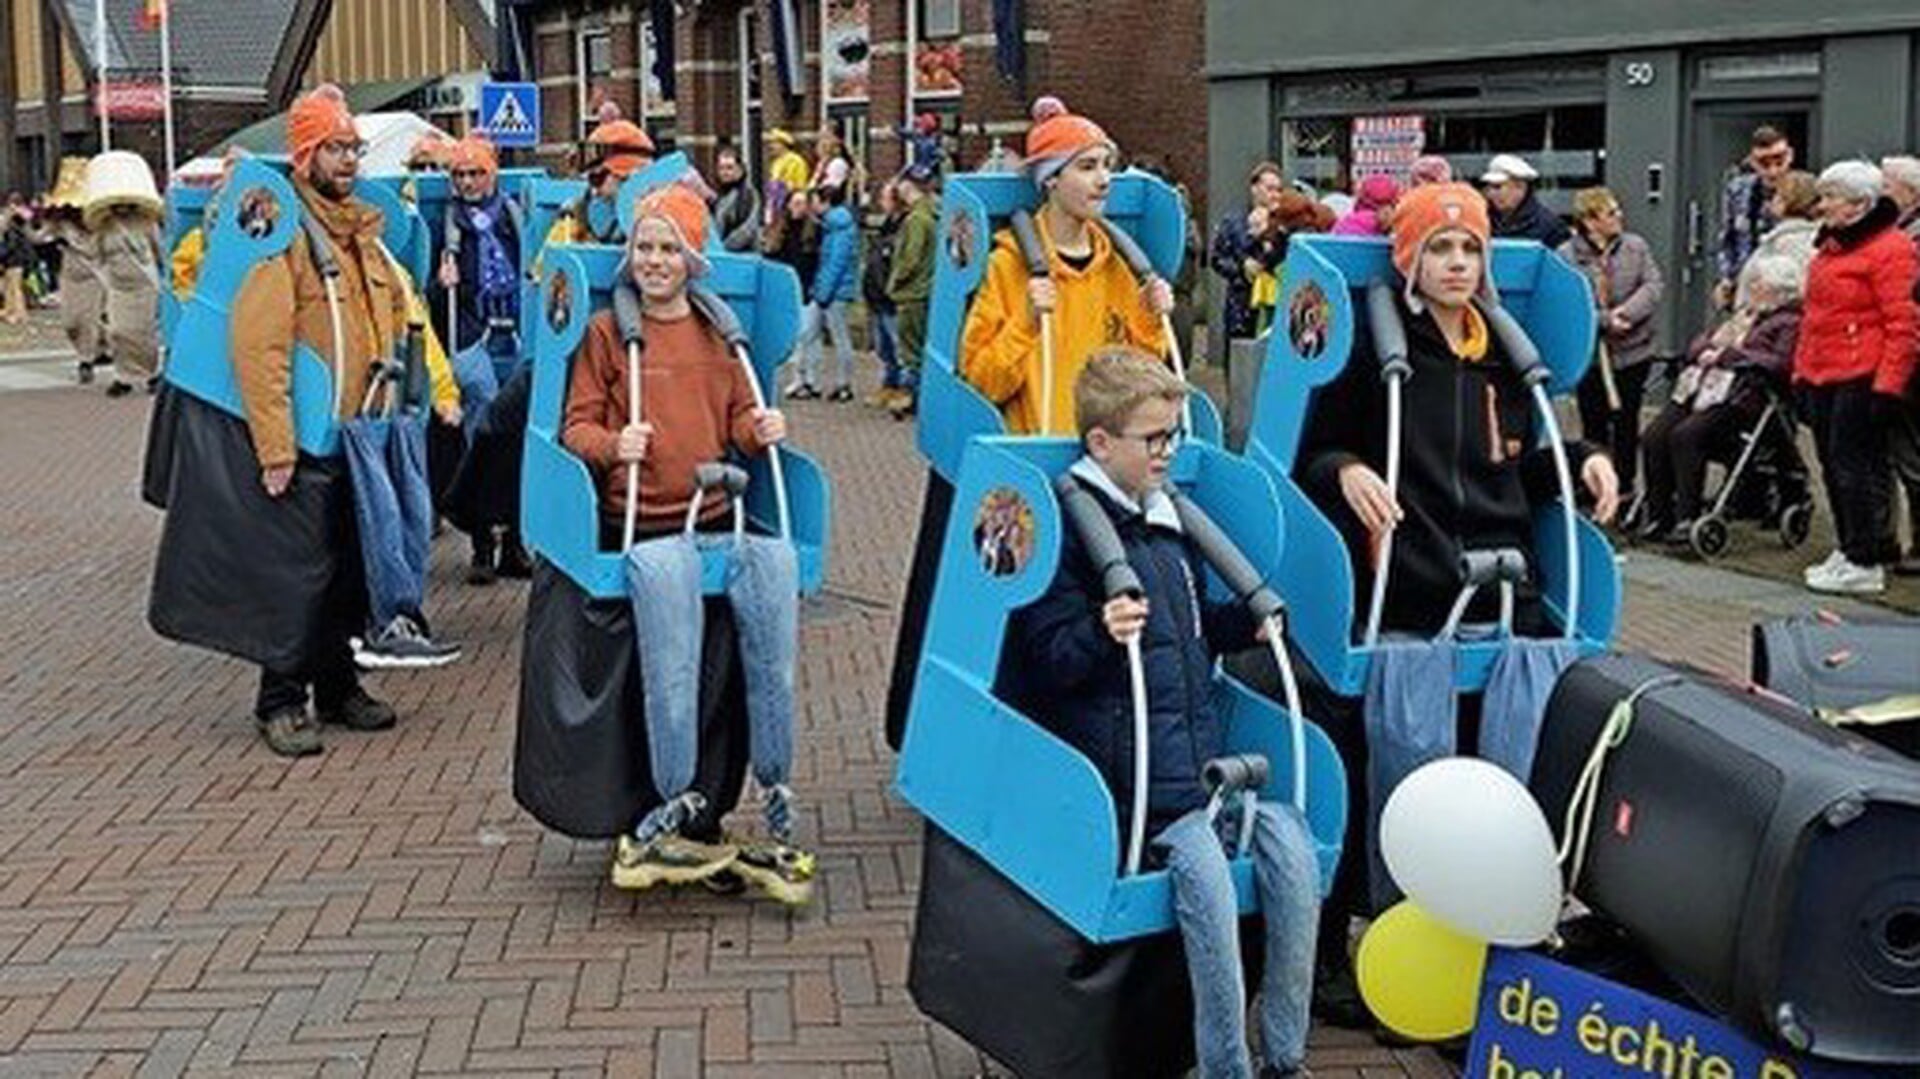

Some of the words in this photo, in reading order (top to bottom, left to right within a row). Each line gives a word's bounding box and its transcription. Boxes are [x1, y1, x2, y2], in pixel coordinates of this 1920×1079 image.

[1626, 62, 1654, 85] 50
[1500, 977, 1560, 1035] de
[1577, 1002, 1733, 1079] échte
